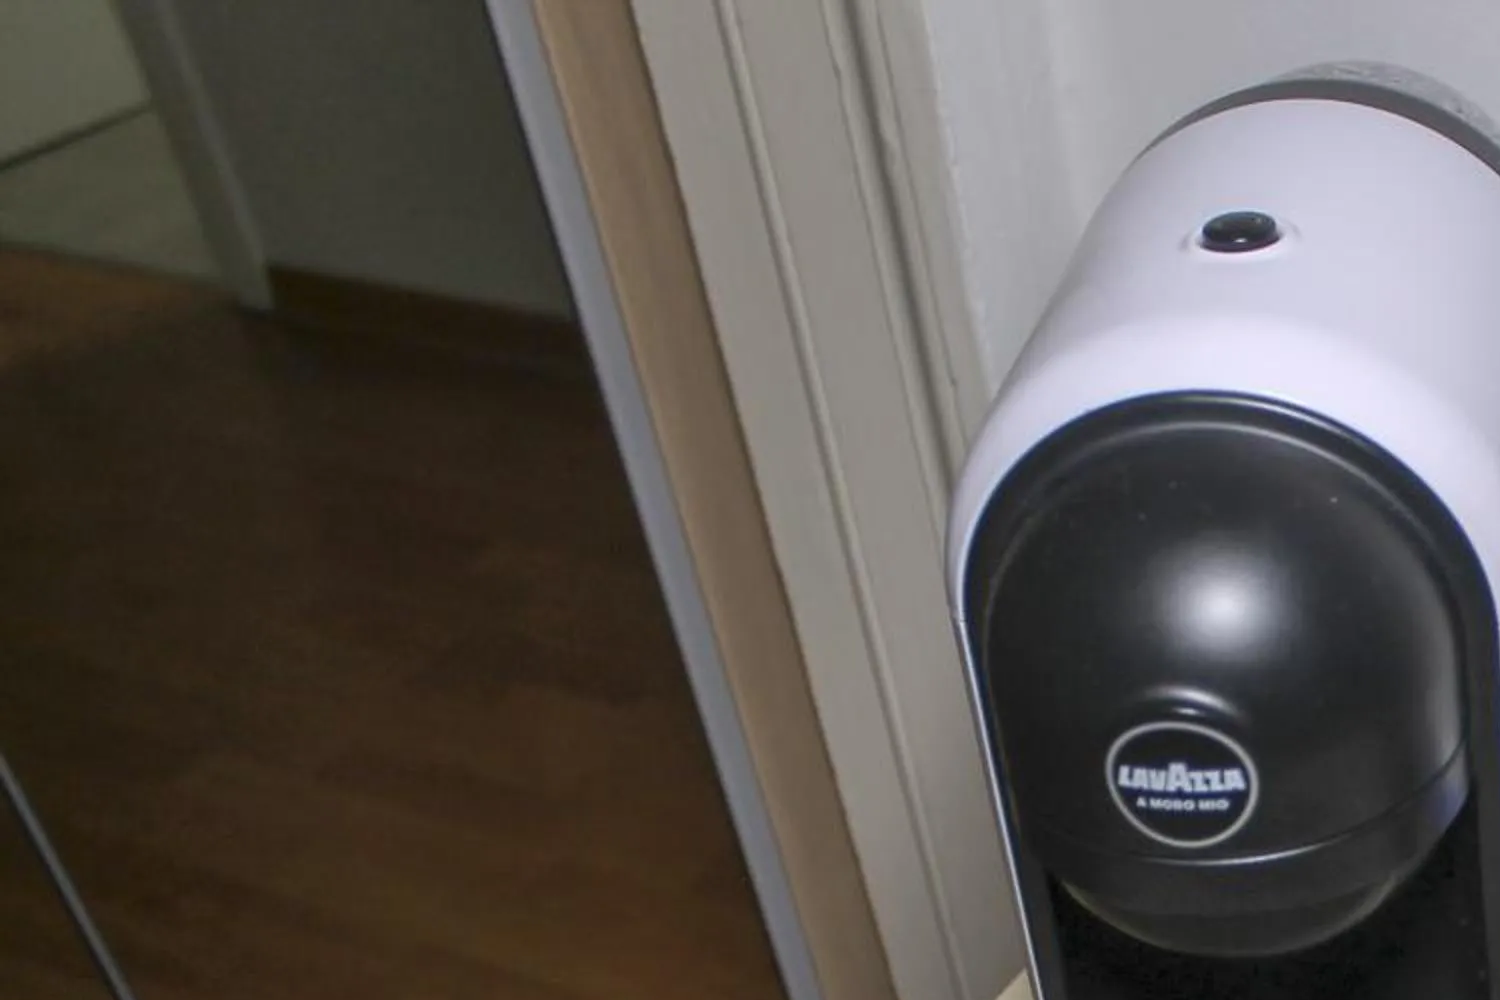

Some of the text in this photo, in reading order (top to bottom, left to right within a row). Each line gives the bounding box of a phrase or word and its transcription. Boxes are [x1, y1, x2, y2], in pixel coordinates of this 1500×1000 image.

[1118, 762, 1246, 792] LAVAZZA
[1136, 797, 1147, 808] A
[1198, 798, 1230, 811] MIO
